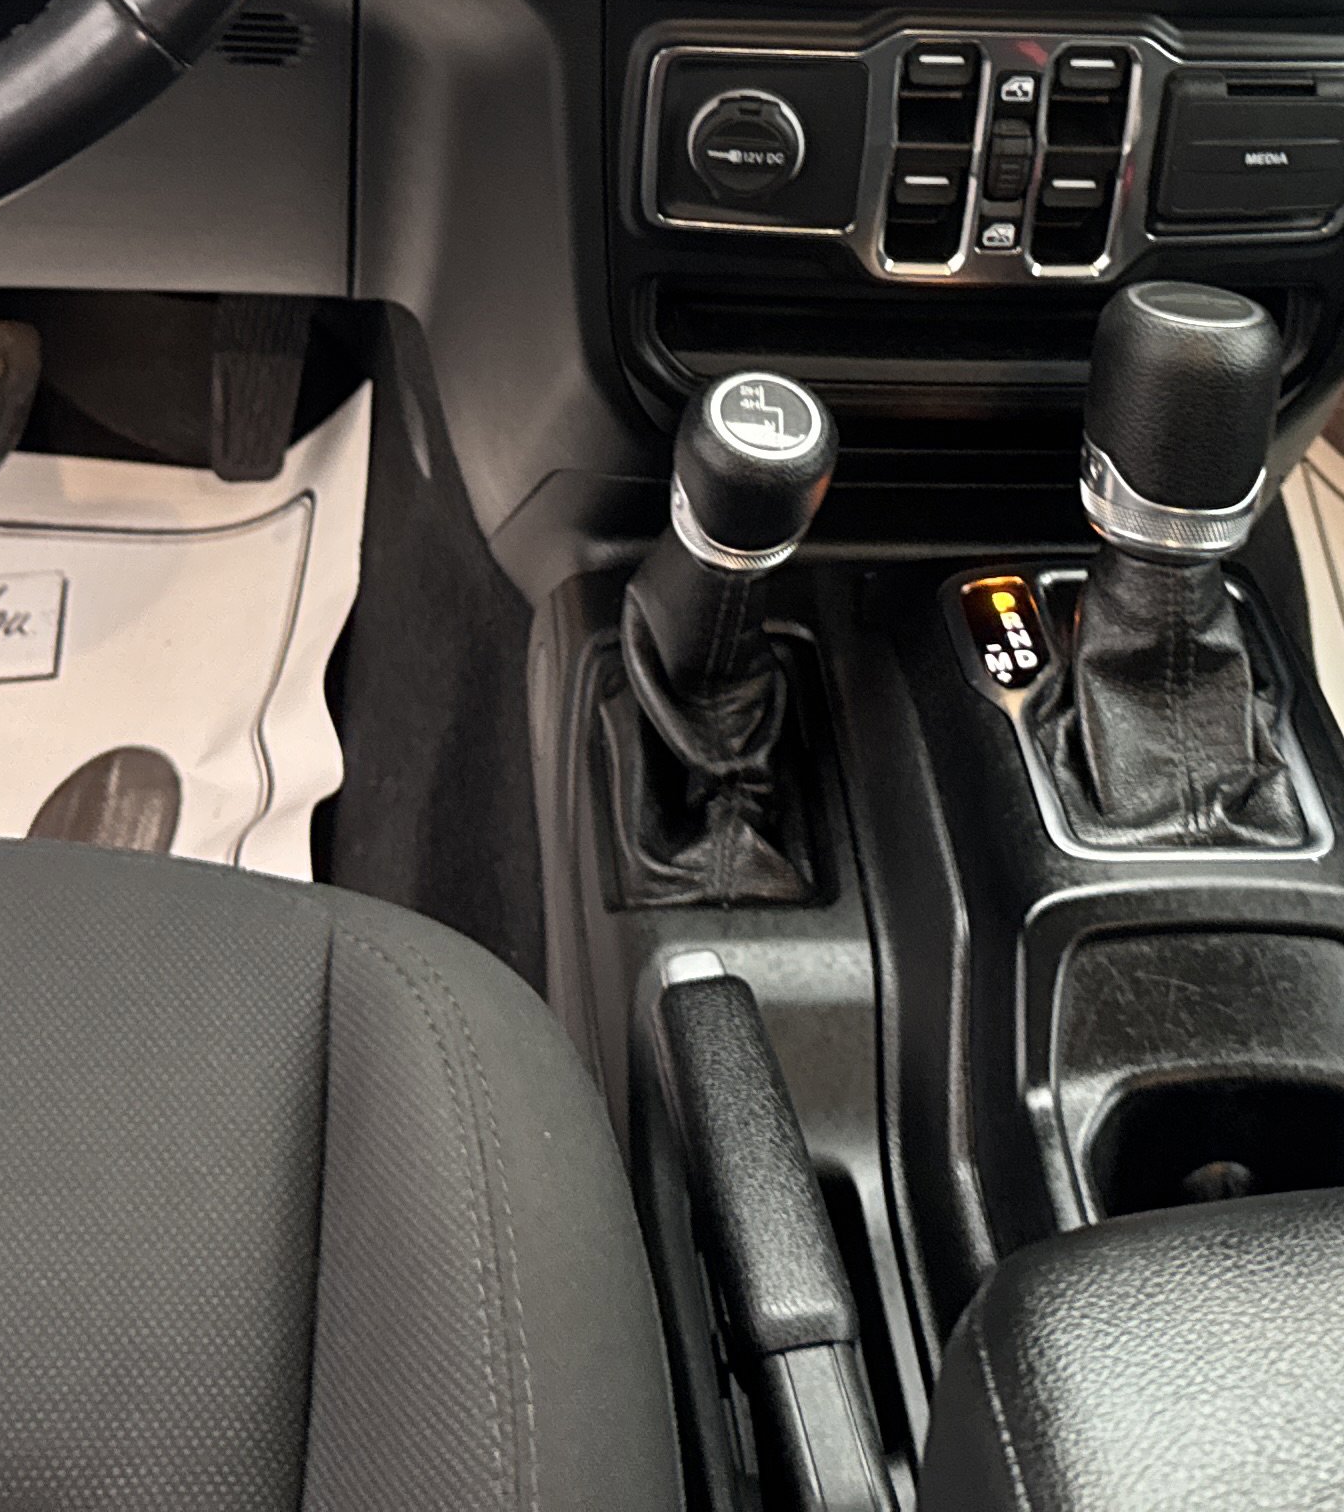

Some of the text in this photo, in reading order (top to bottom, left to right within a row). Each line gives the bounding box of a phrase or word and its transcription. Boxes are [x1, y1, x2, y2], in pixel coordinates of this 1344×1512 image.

[766, 152, 785, 165] DC
[1245, 151, 1289, 165] MEDIA
[1007, 629, 1032, 649] N
[1014, 649, 1037, 668] D
